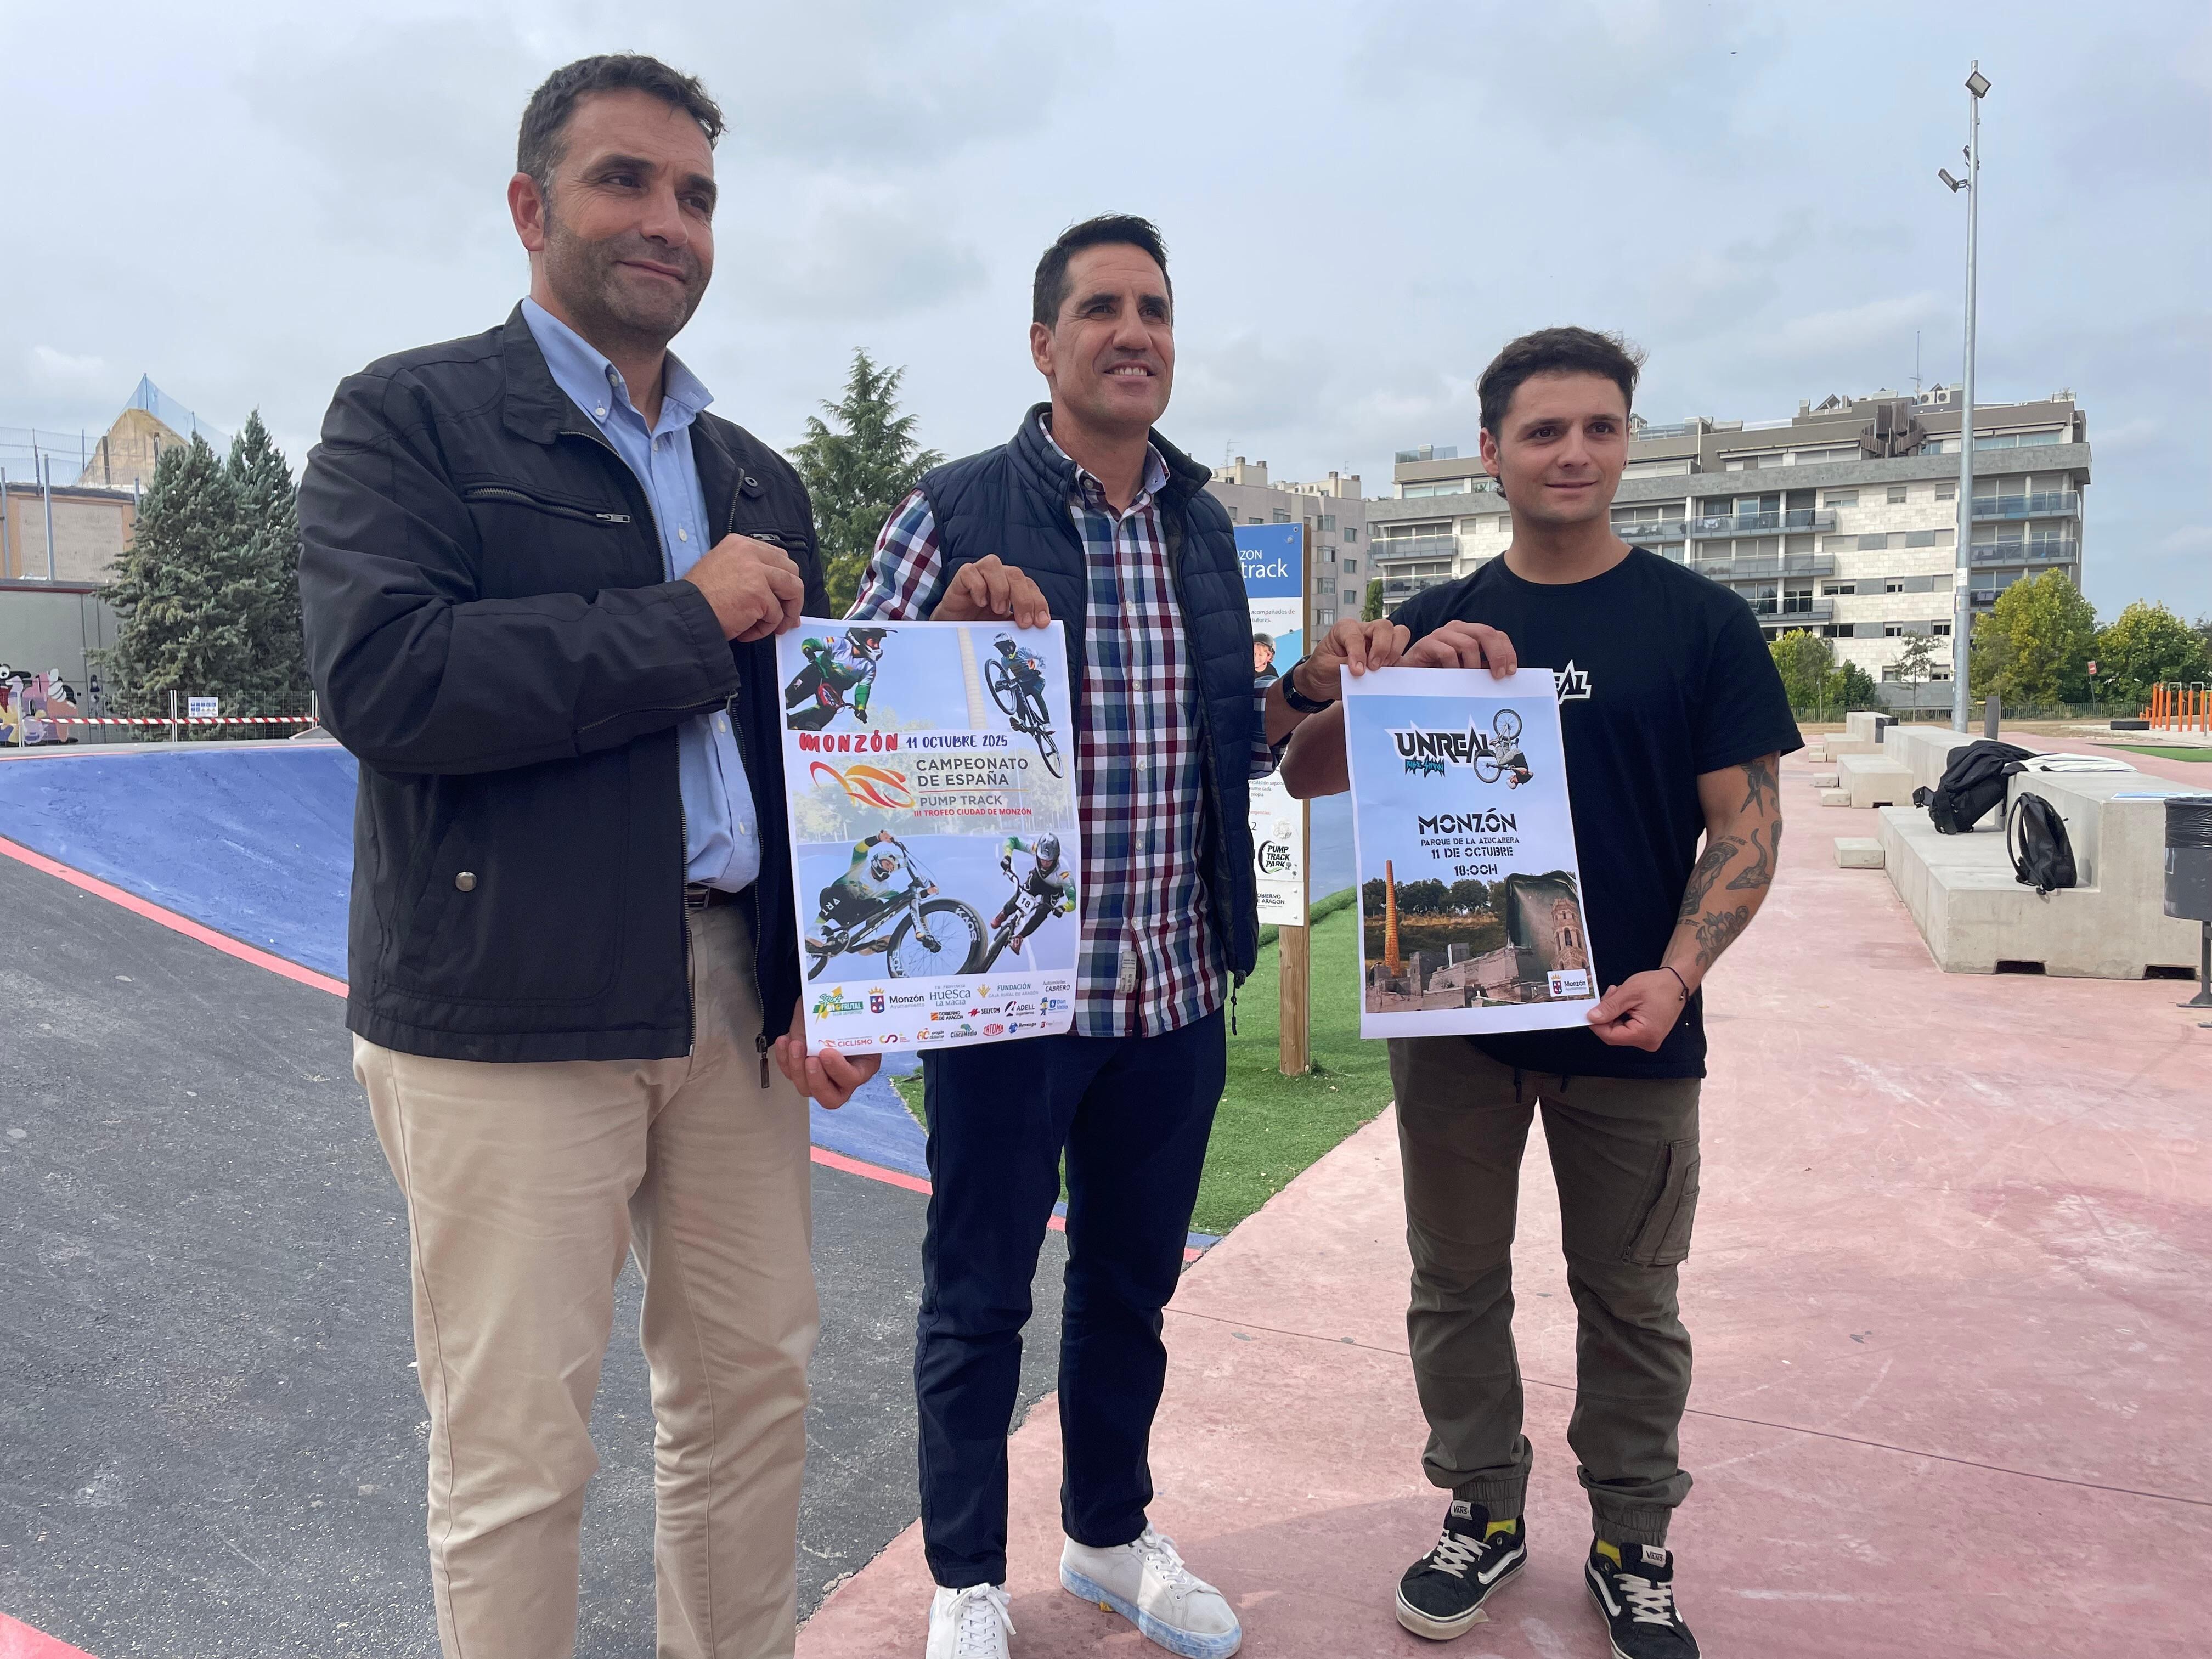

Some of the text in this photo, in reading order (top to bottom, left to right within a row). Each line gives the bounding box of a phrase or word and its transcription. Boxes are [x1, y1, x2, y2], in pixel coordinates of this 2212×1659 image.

[1238, 550, 1262, 560] ZON
[1241, 558, 1288, 578] track
[799, 730, 1008, 753] MONZÓN 11 OCTUBRE 2025
[1394, 727, 1495, 763] UNREAL
[916, 758, 1028, 771] CAMPEONATO
[917, 770, 1009, 787] DE ESPAÑA
[920, 795, 1002, 806] PUMP TRACK
[999, 807, 1032, 815] MONZÓN
[1418, 808, 1517, 834] MONZÓN
[1267, 853, 1290, 861] TRACK
[1431, 846, 1514, 859] 11 DE OCTUBRE
[1454, 864, 1498, 876] 18:00H
[1022, 897, 1030, 908] 18
[997, 983, 1031, 991] FUNDACIÓN
[819, 993, 844, 1006] Sport
[889, 994, 924, 1003] Monzón
[929, 989, 970, 1000] Huesca
[1453, 1505, 1468, 1514] VANS
[1646, 1550, 1663, 1562] VANS
